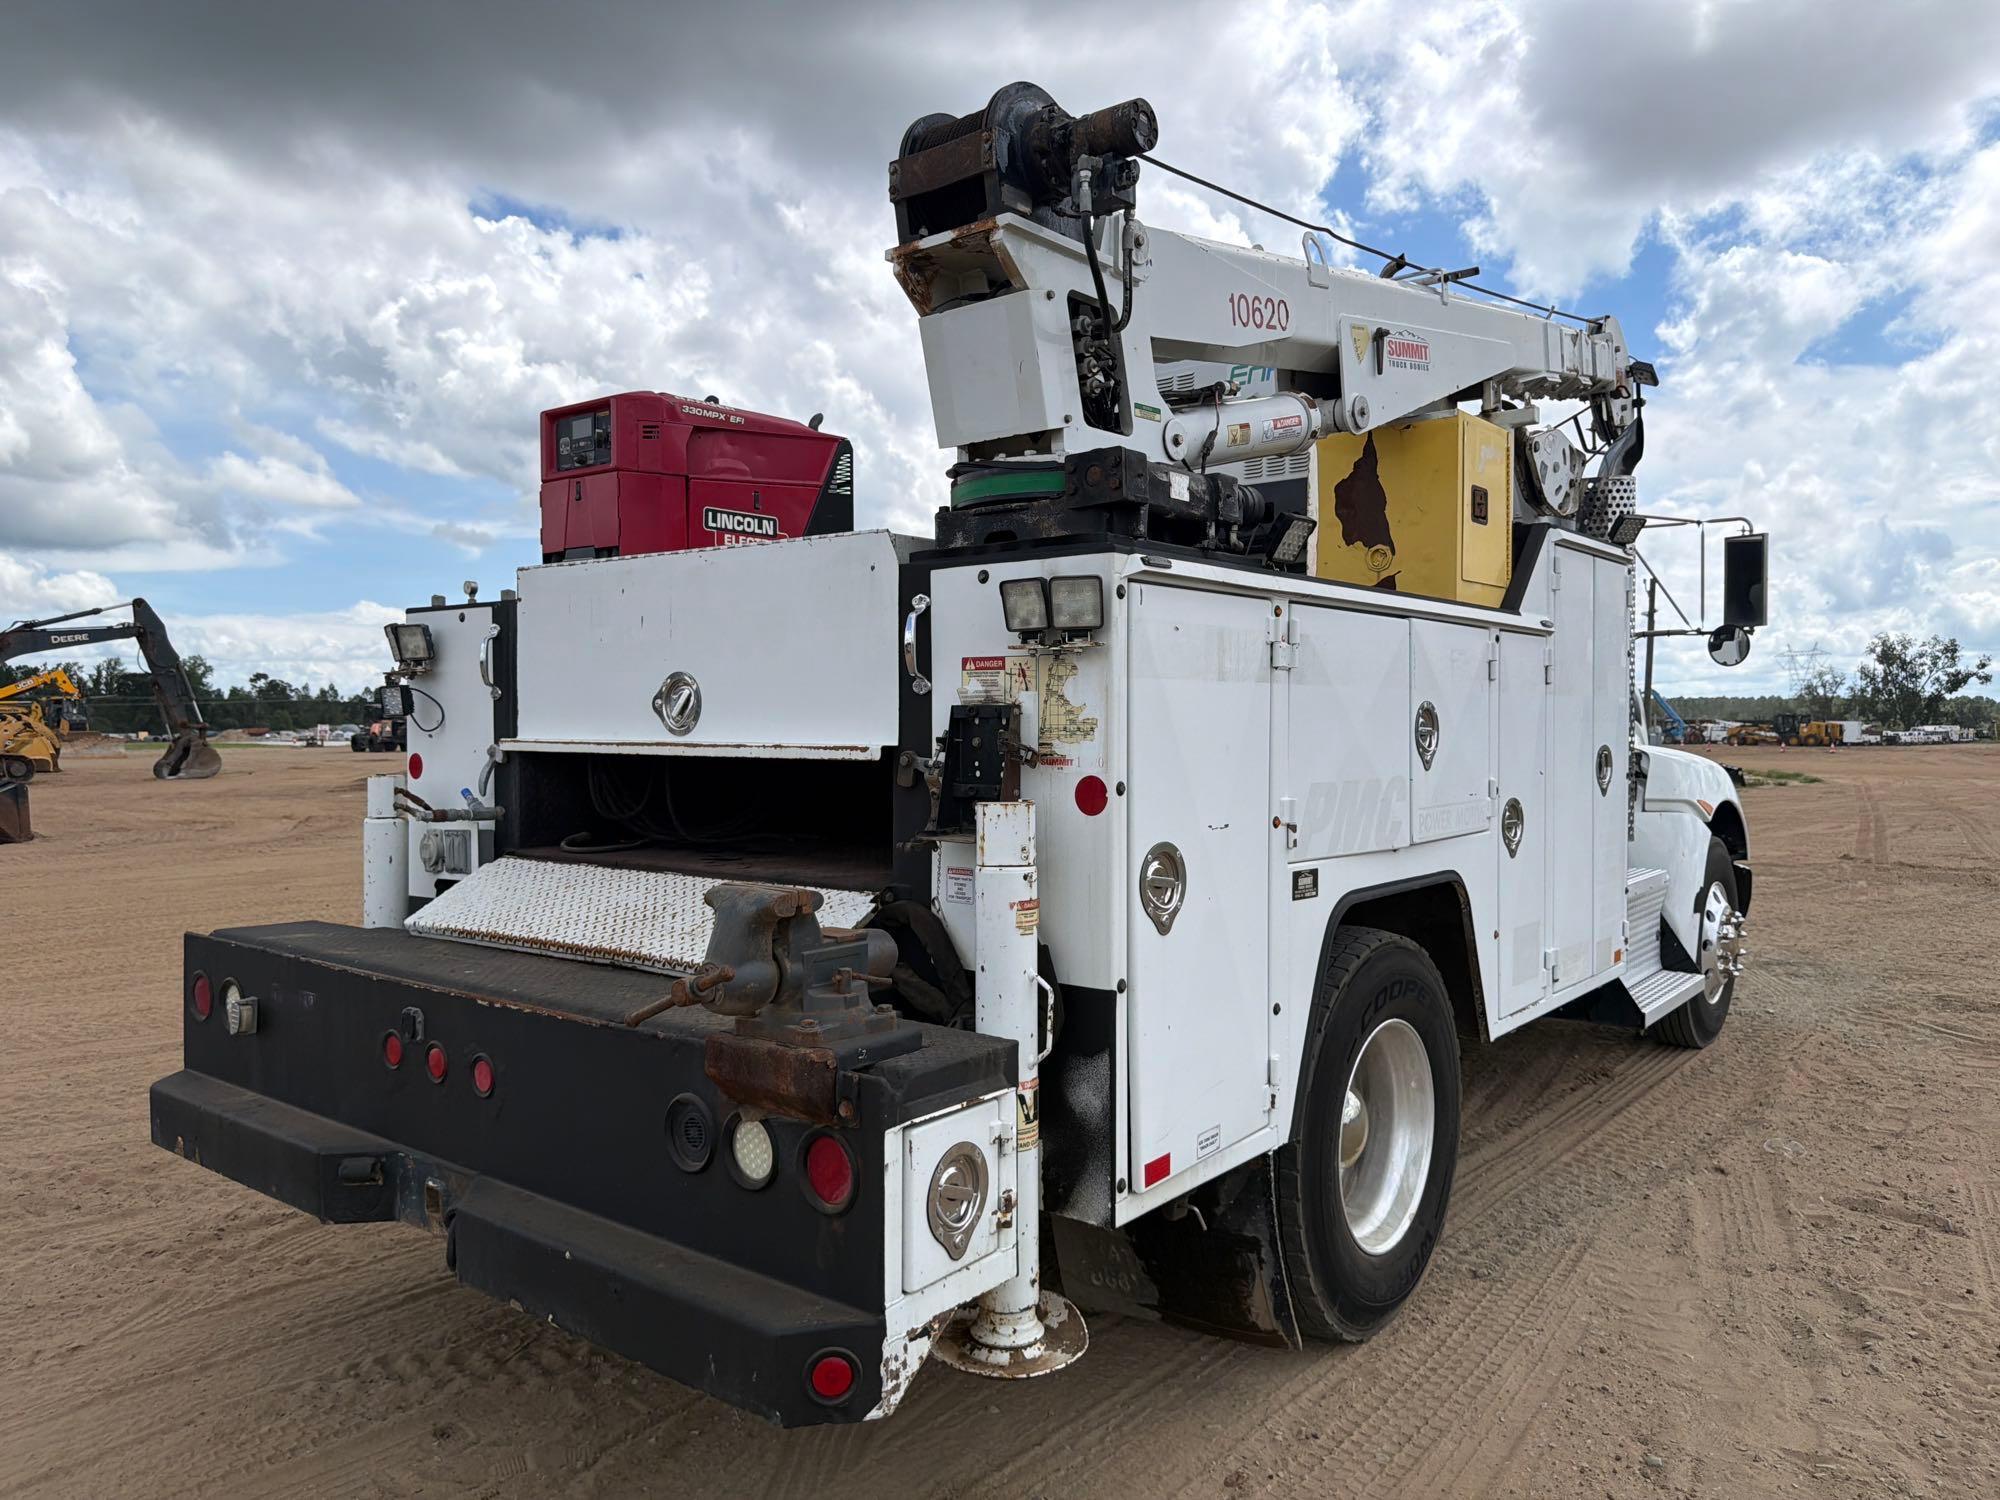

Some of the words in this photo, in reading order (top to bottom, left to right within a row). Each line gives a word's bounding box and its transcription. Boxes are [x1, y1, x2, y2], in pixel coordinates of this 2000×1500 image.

[1229, 293, 1289, 331] 10620
[1387, 339, 1429, 361] SUMMIT
[1389, 360, 1407, 368] TRUCK
[729, 416, 745, 424] EFI
[708, 511, 774, 536] LINCOLN
[51, 633, 89, 644] DEERE
[975, 660, 1003, 668] DANGER
[1040, 758, 1073, 766] SUMMIT
